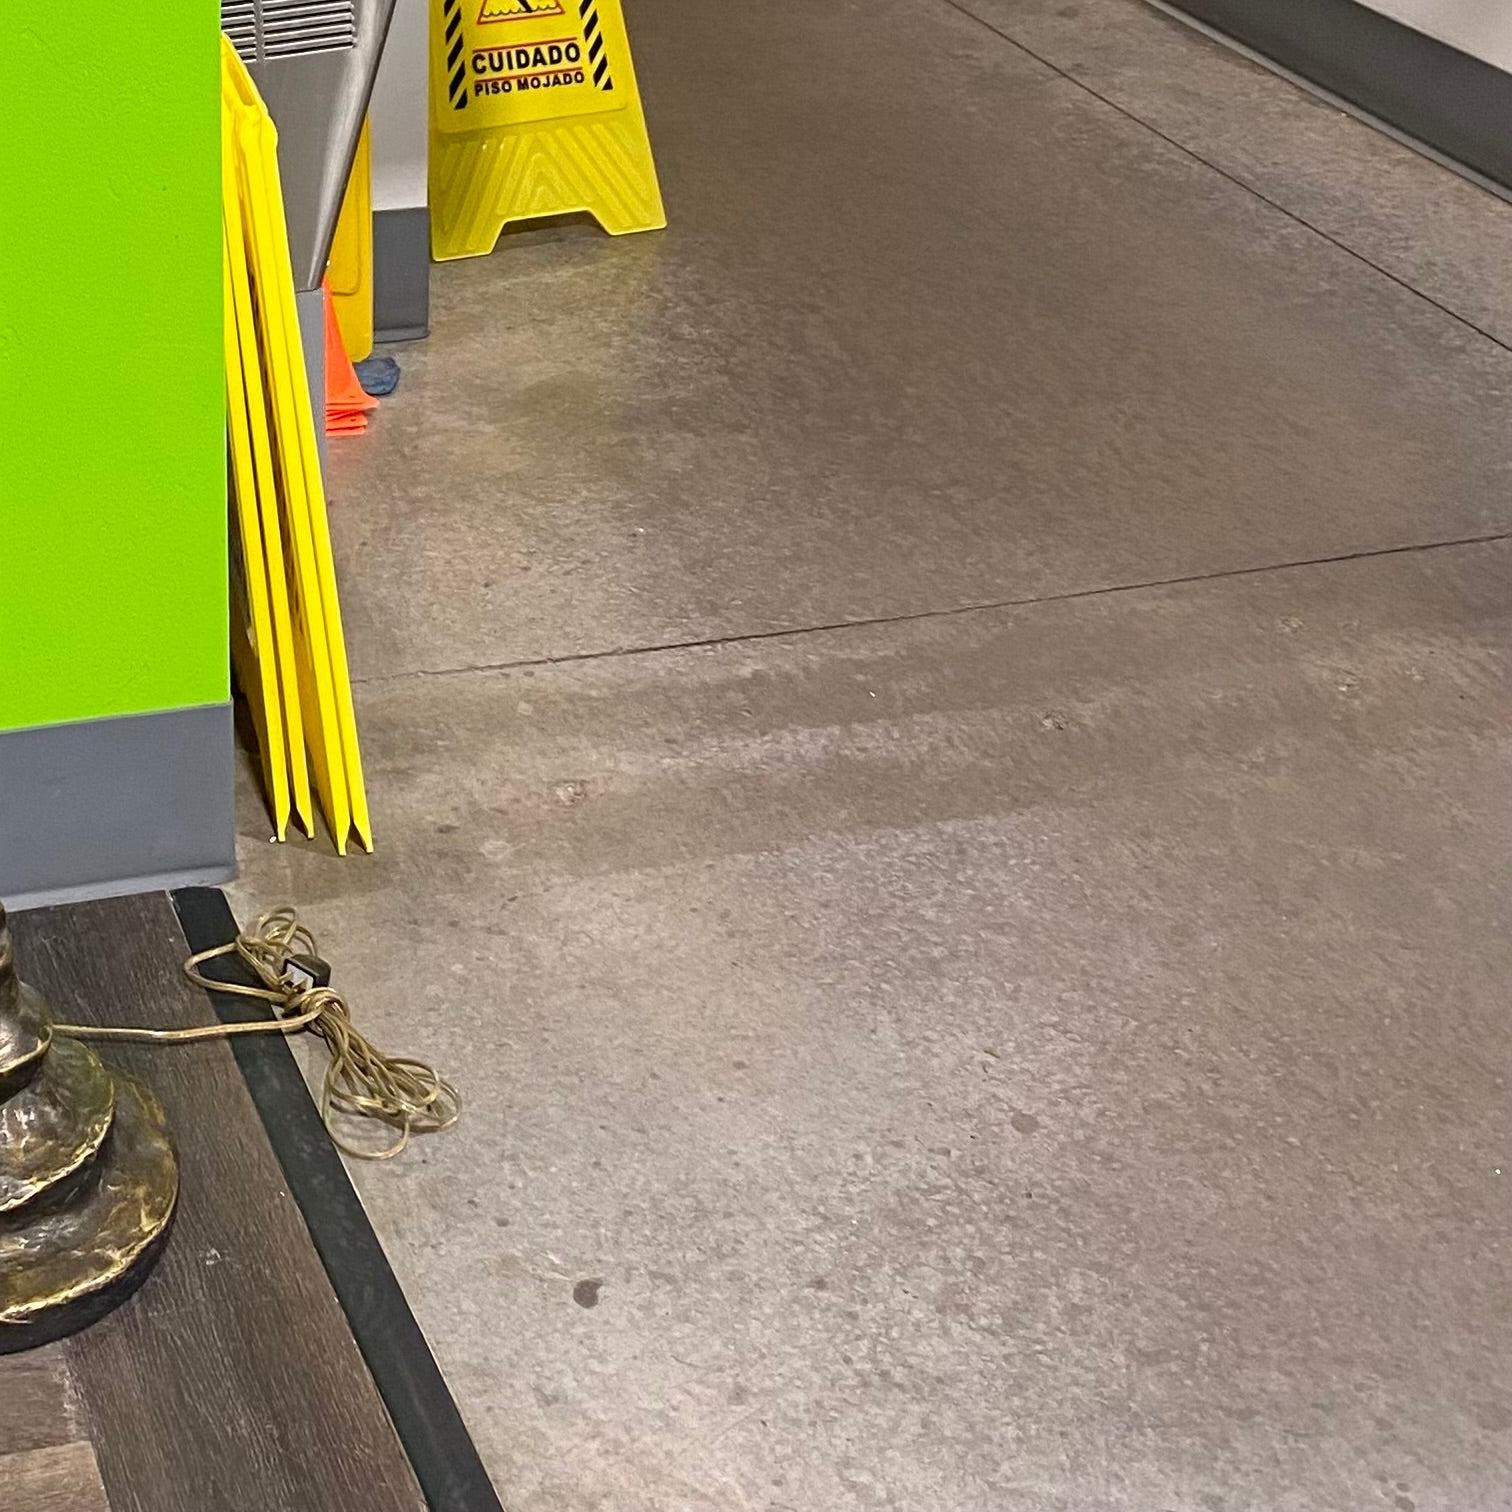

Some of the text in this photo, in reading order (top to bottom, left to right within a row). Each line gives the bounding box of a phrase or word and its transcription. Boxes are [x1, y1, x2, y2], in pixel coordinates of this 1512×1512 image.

[471, 42, 581, 75] CUIDADO
[474, 71, 585, 97] PISO MOJADO
